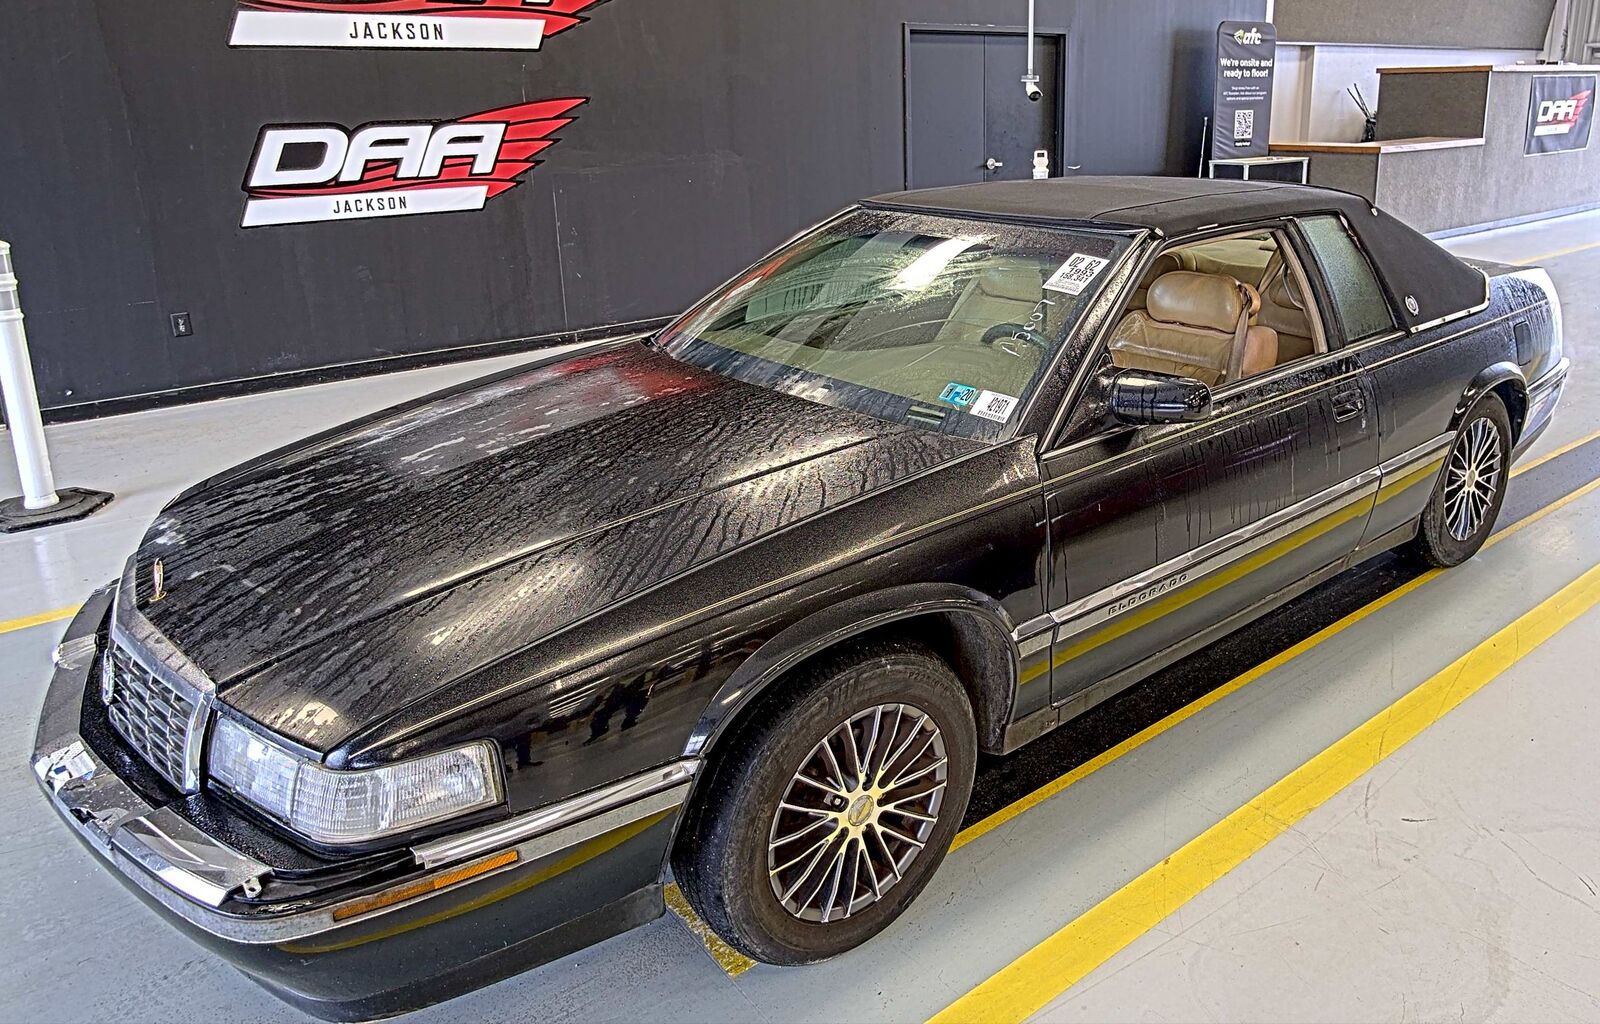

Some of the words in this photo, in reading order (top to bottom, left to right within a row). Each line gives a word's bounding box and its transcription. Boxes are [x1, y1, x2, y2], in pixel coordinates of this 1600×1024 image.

[350, 22, 444, 40] JACKSON
[1243, 28, 1262, 44] afc
[1220, 58, 1239, 67] We're
[1240, 58, 1260, 67] onsite
[1261, 58, 1273, 67] and
[1223, 69, 1242, 79] ready
[1243, 69, 1250, 77] to
[1251, 69, 1268, 77] floor!
[1537, 100, 1578, 122] DAA
[249, 123, 507, 187] DAA
[333, 196, 407, 214] JACKSON
[961, 388, 975, 402] 20
[1108, 573, 1189, 615] ELDORADO
